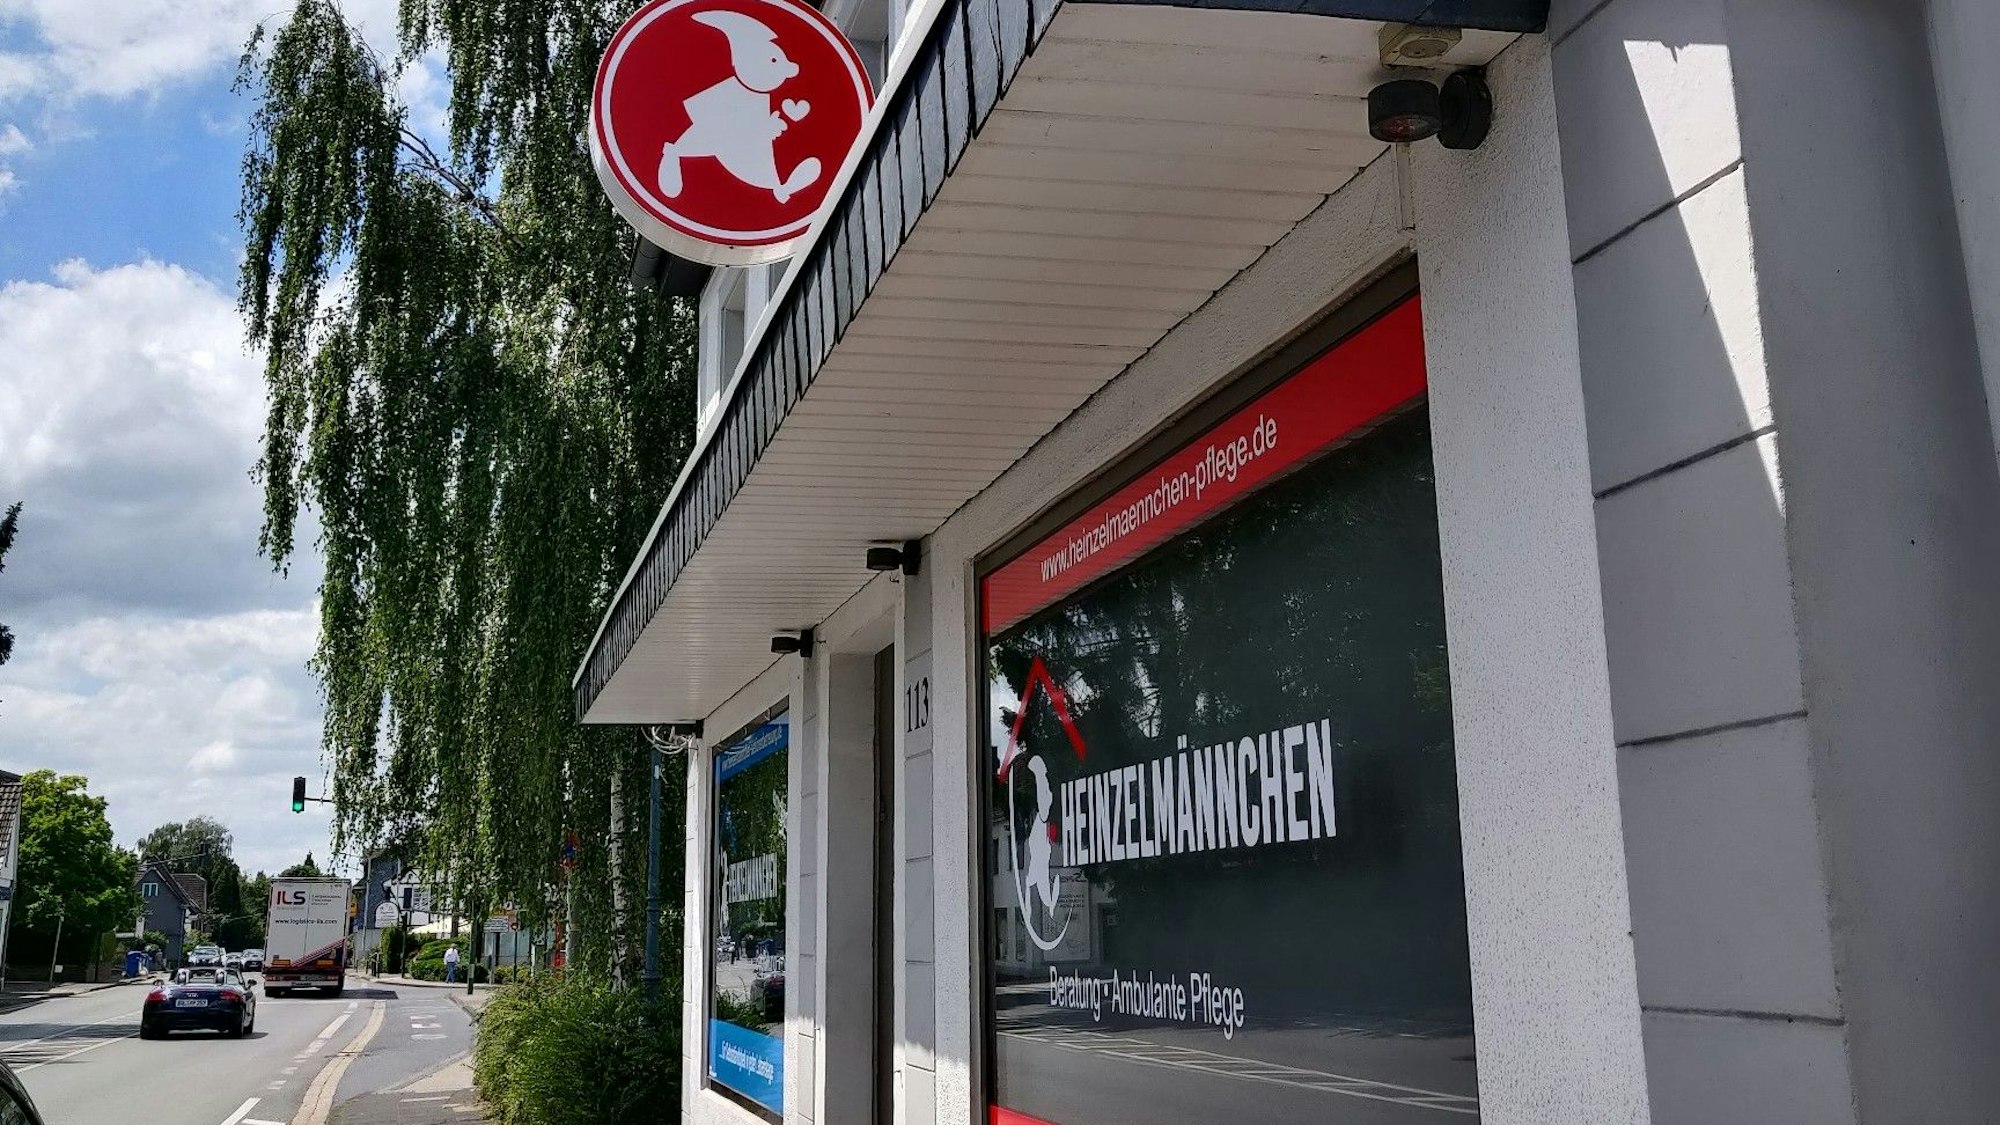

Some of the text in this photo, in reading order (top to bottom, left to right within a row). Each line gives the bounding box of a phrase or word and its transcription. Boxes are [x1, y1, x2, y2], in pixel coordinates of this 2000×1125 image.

[1040, 414, 1278, 583] www.heinzelmaennchen-pflege.de
[907, 677, 928, 733] 113
[1061, 718, 1337, 868] HEINZELMÄNNCHEN
[276, 890, 306, 906] ILS
[1050, 965, 1245, 1041] Beratung Ambulante Pflege
